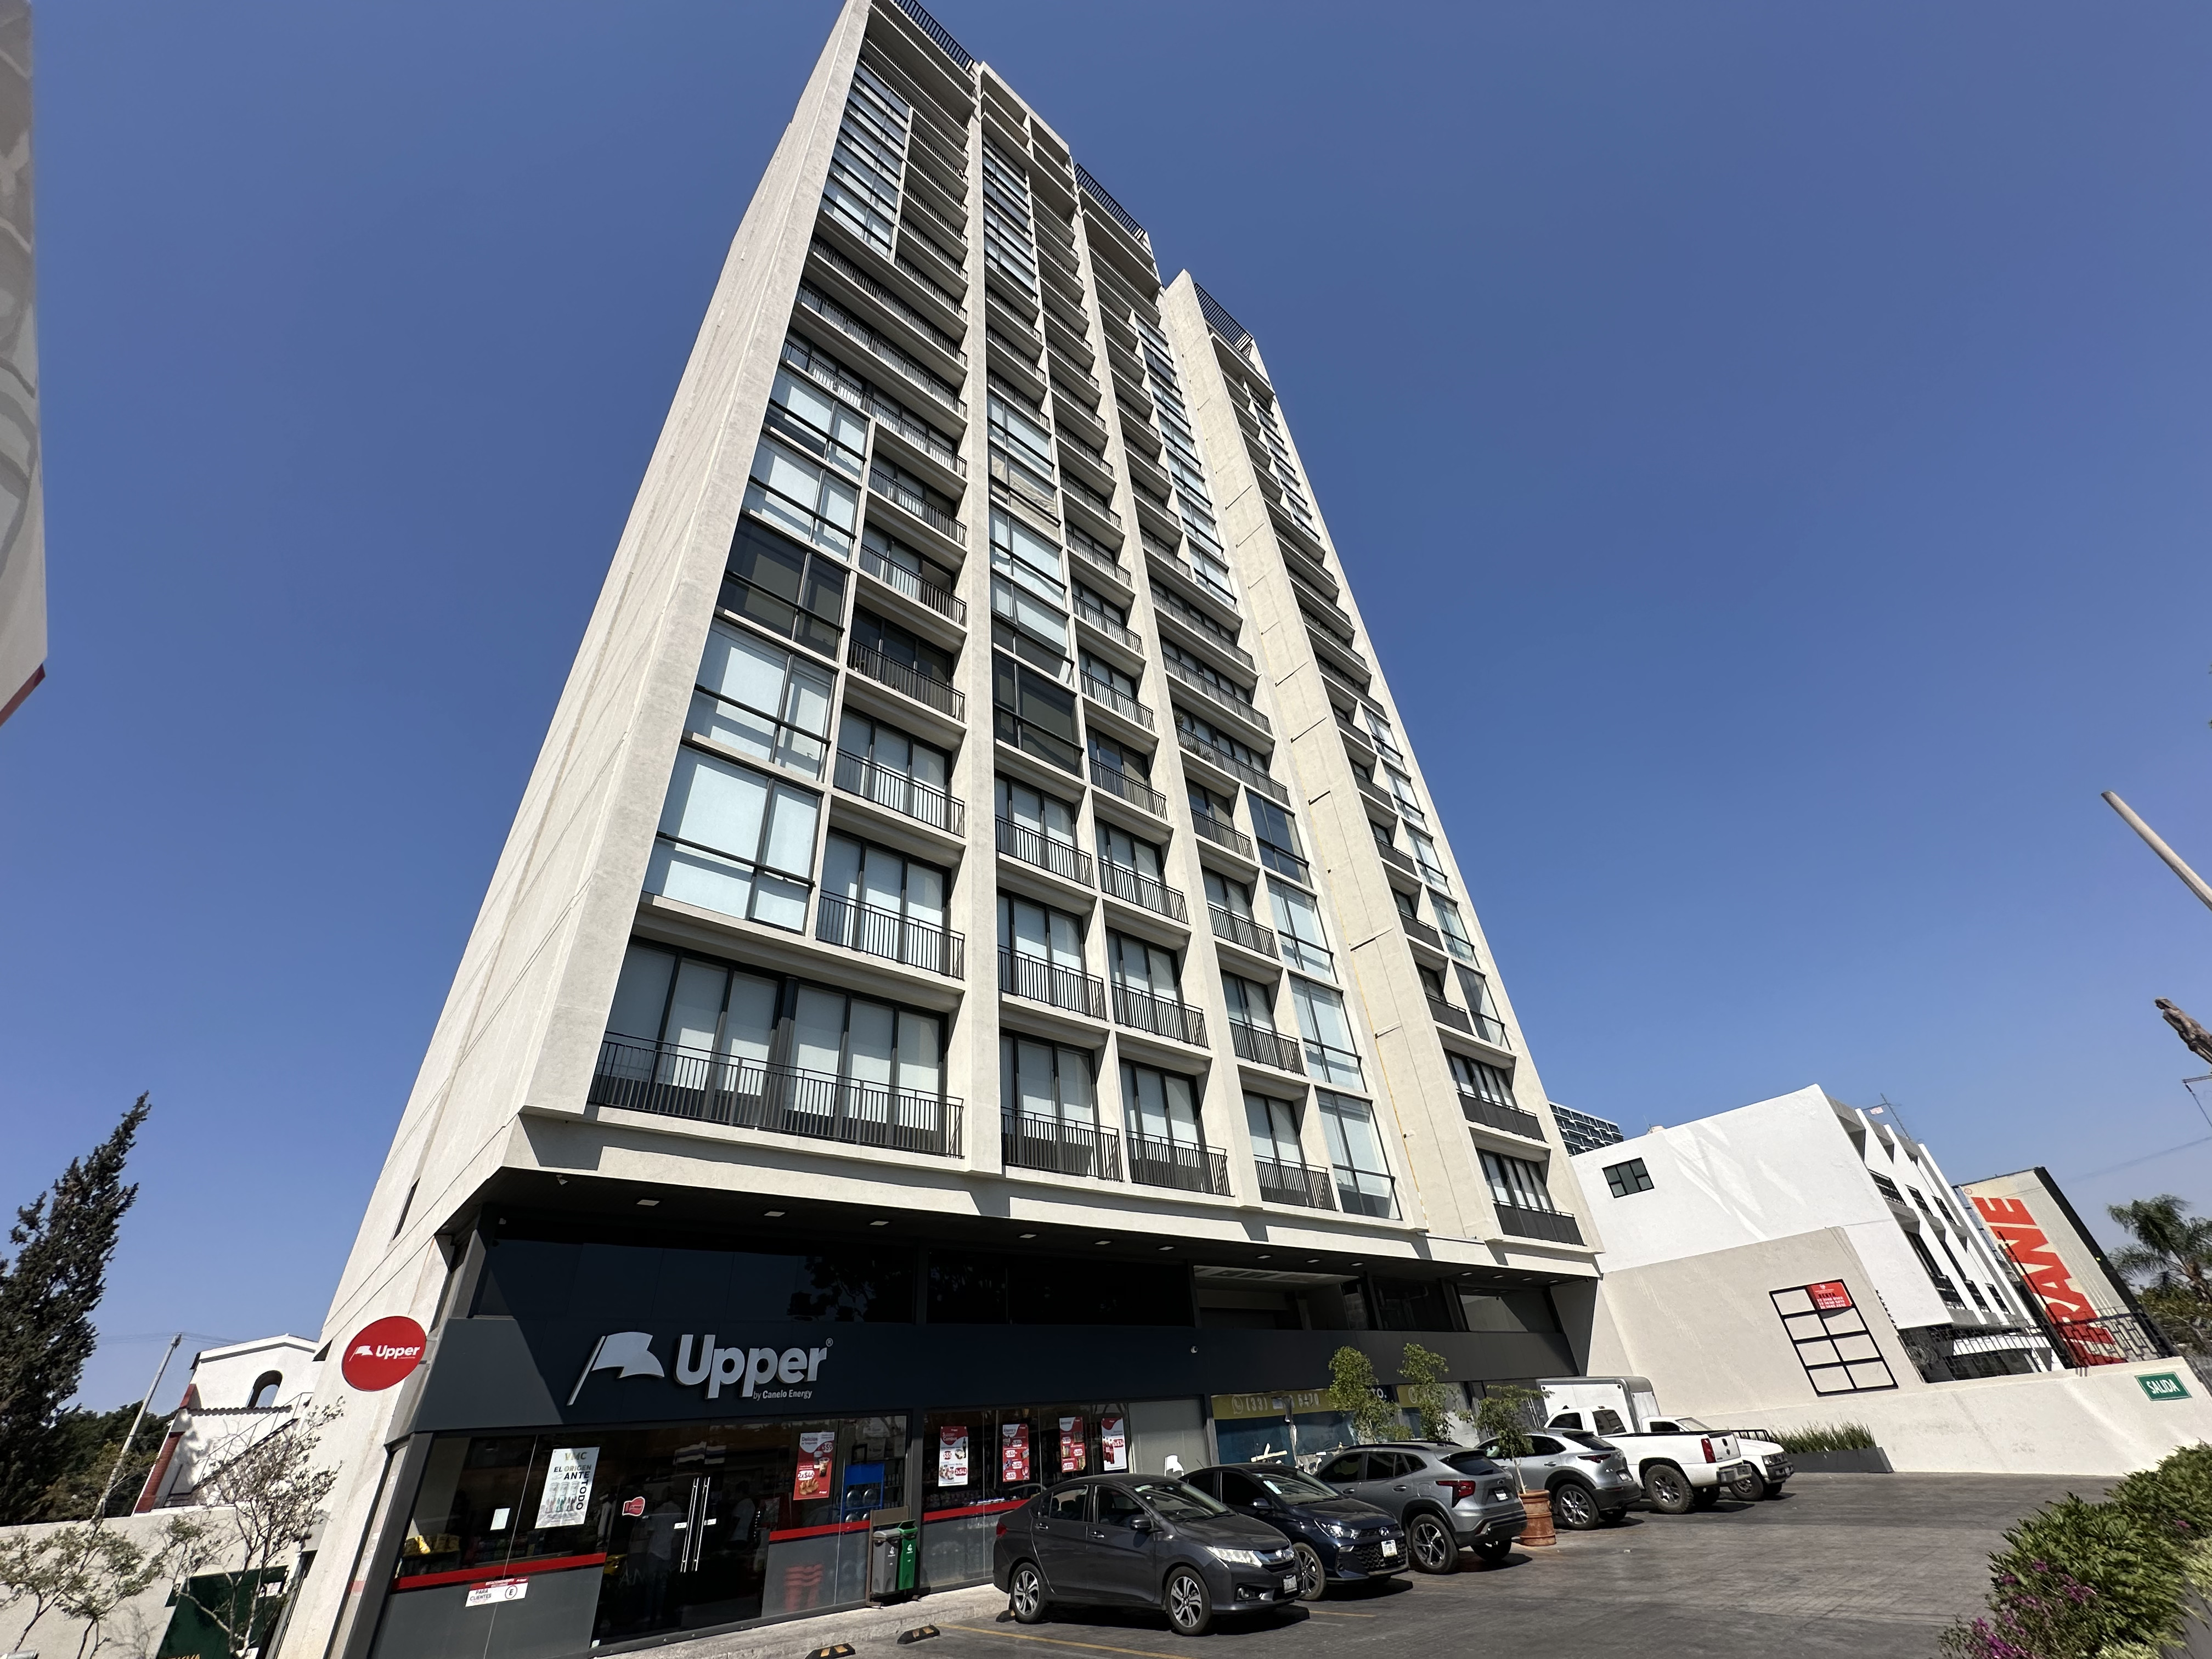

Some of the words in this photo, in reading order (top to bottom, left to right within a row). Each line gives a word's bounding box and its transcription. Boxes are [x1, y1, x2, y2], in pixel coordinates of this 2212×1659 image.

[376, 1345, 420, 1359] Upper
[674, 1334, 827, 1399] Upper
[2146, 1379, 2181, 1394] SALIDA
[753, 1391, 761, 1401] by
[762, 1390, 787, 1398] Canelo
[788, 1389, 812, 1399] Energy
[1246, 1397, 1268, 1412] (33)
[565, 1452, 587, 1461] VMC
[563, 1471, 590, 1480] ANTE
[576, 1479, 589, 1510] TODO
